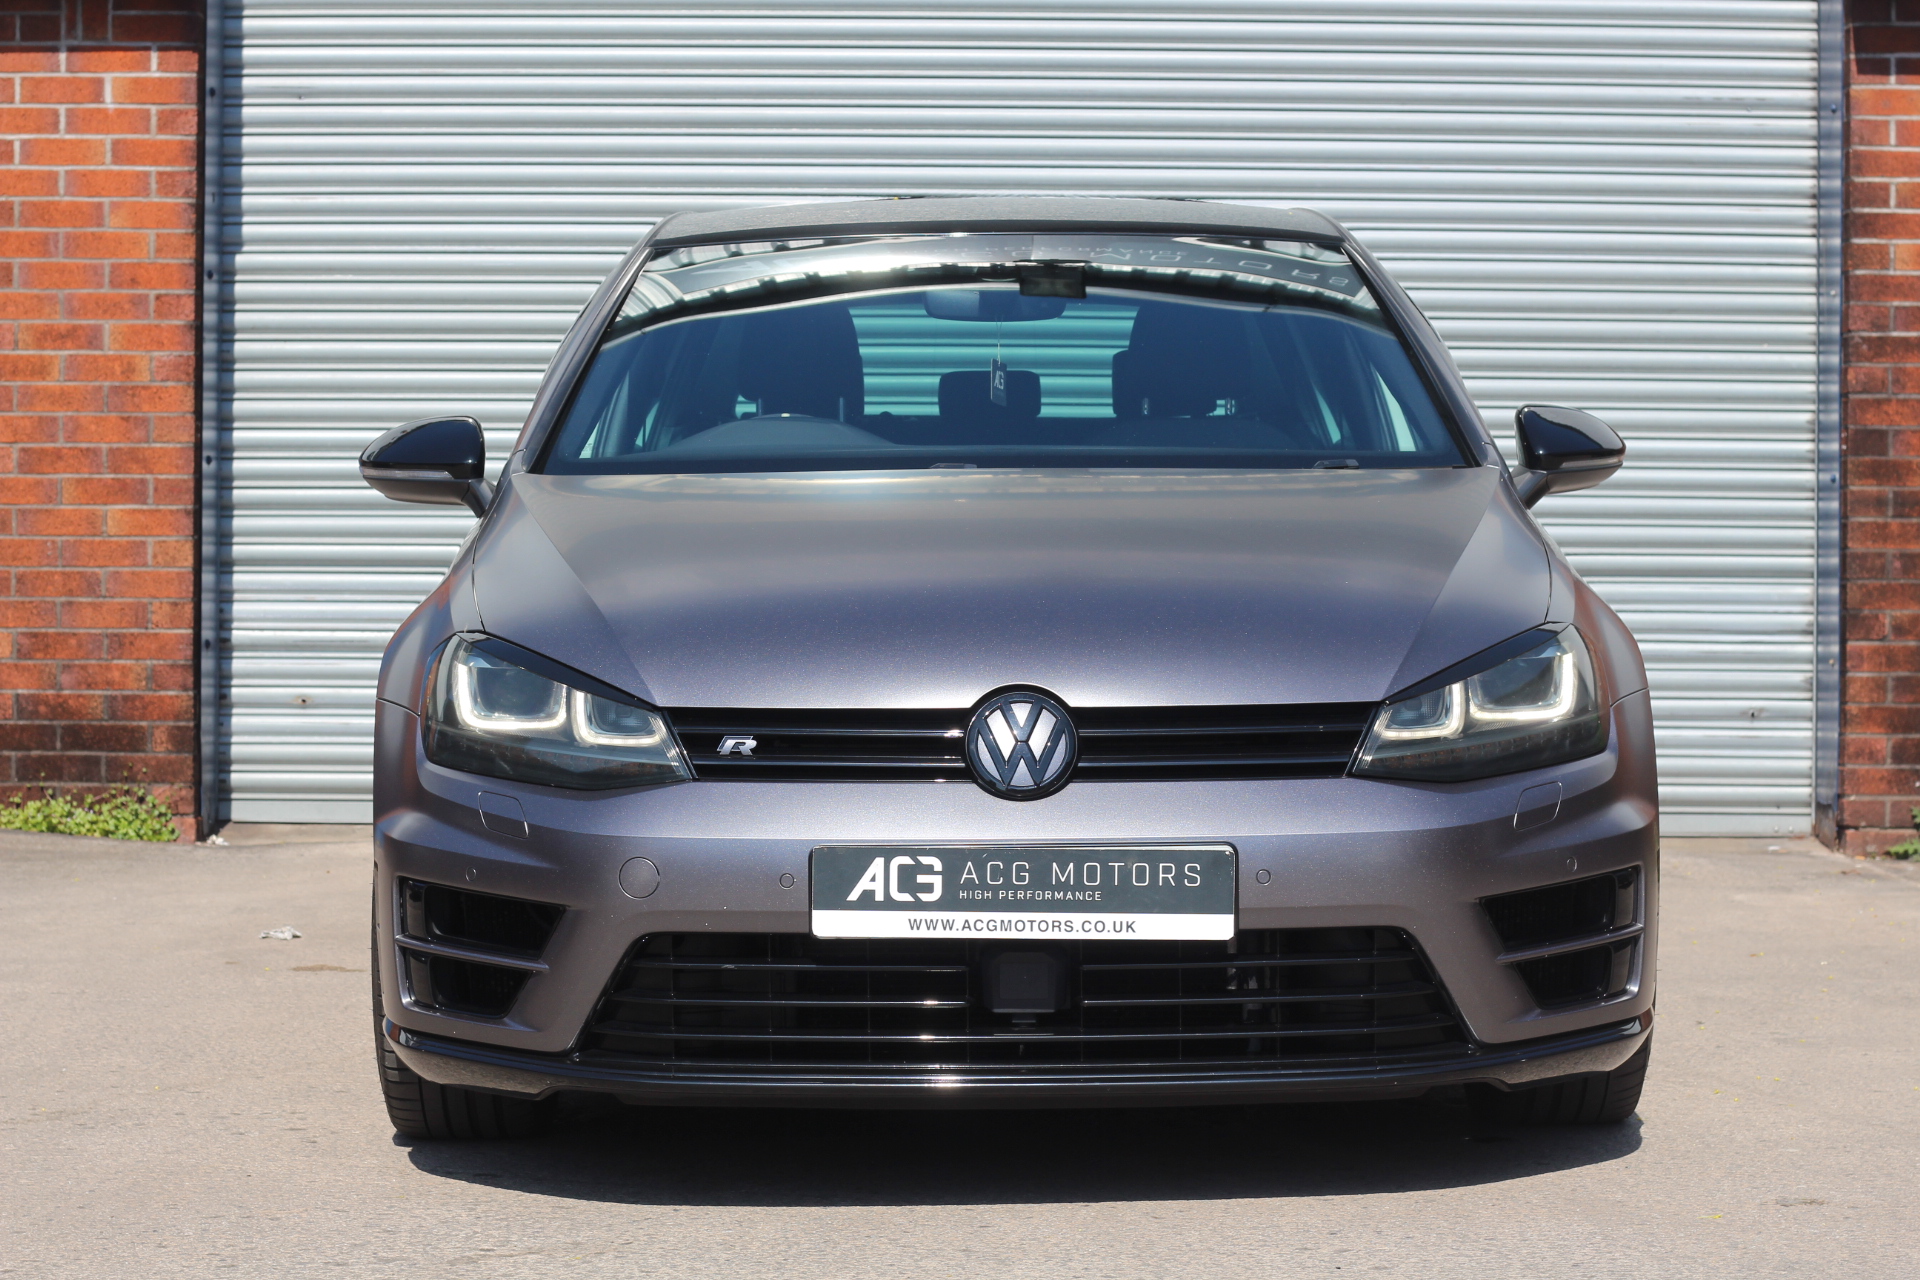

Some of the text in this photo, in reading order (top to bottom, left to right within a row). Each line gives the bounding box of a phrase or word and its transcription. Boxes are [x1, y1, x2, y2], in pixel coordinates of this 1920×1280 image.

[717, 735, 757, 756] R
[846, 856, 943, 902] ACG
[960, 861, 1203, 888] ACG MOTORS
[959, 889, 1103, 902] HIGH PERFORMANCE
[908, 917, 1136, 934] WWW.ACGMOTORS.CO.UK
